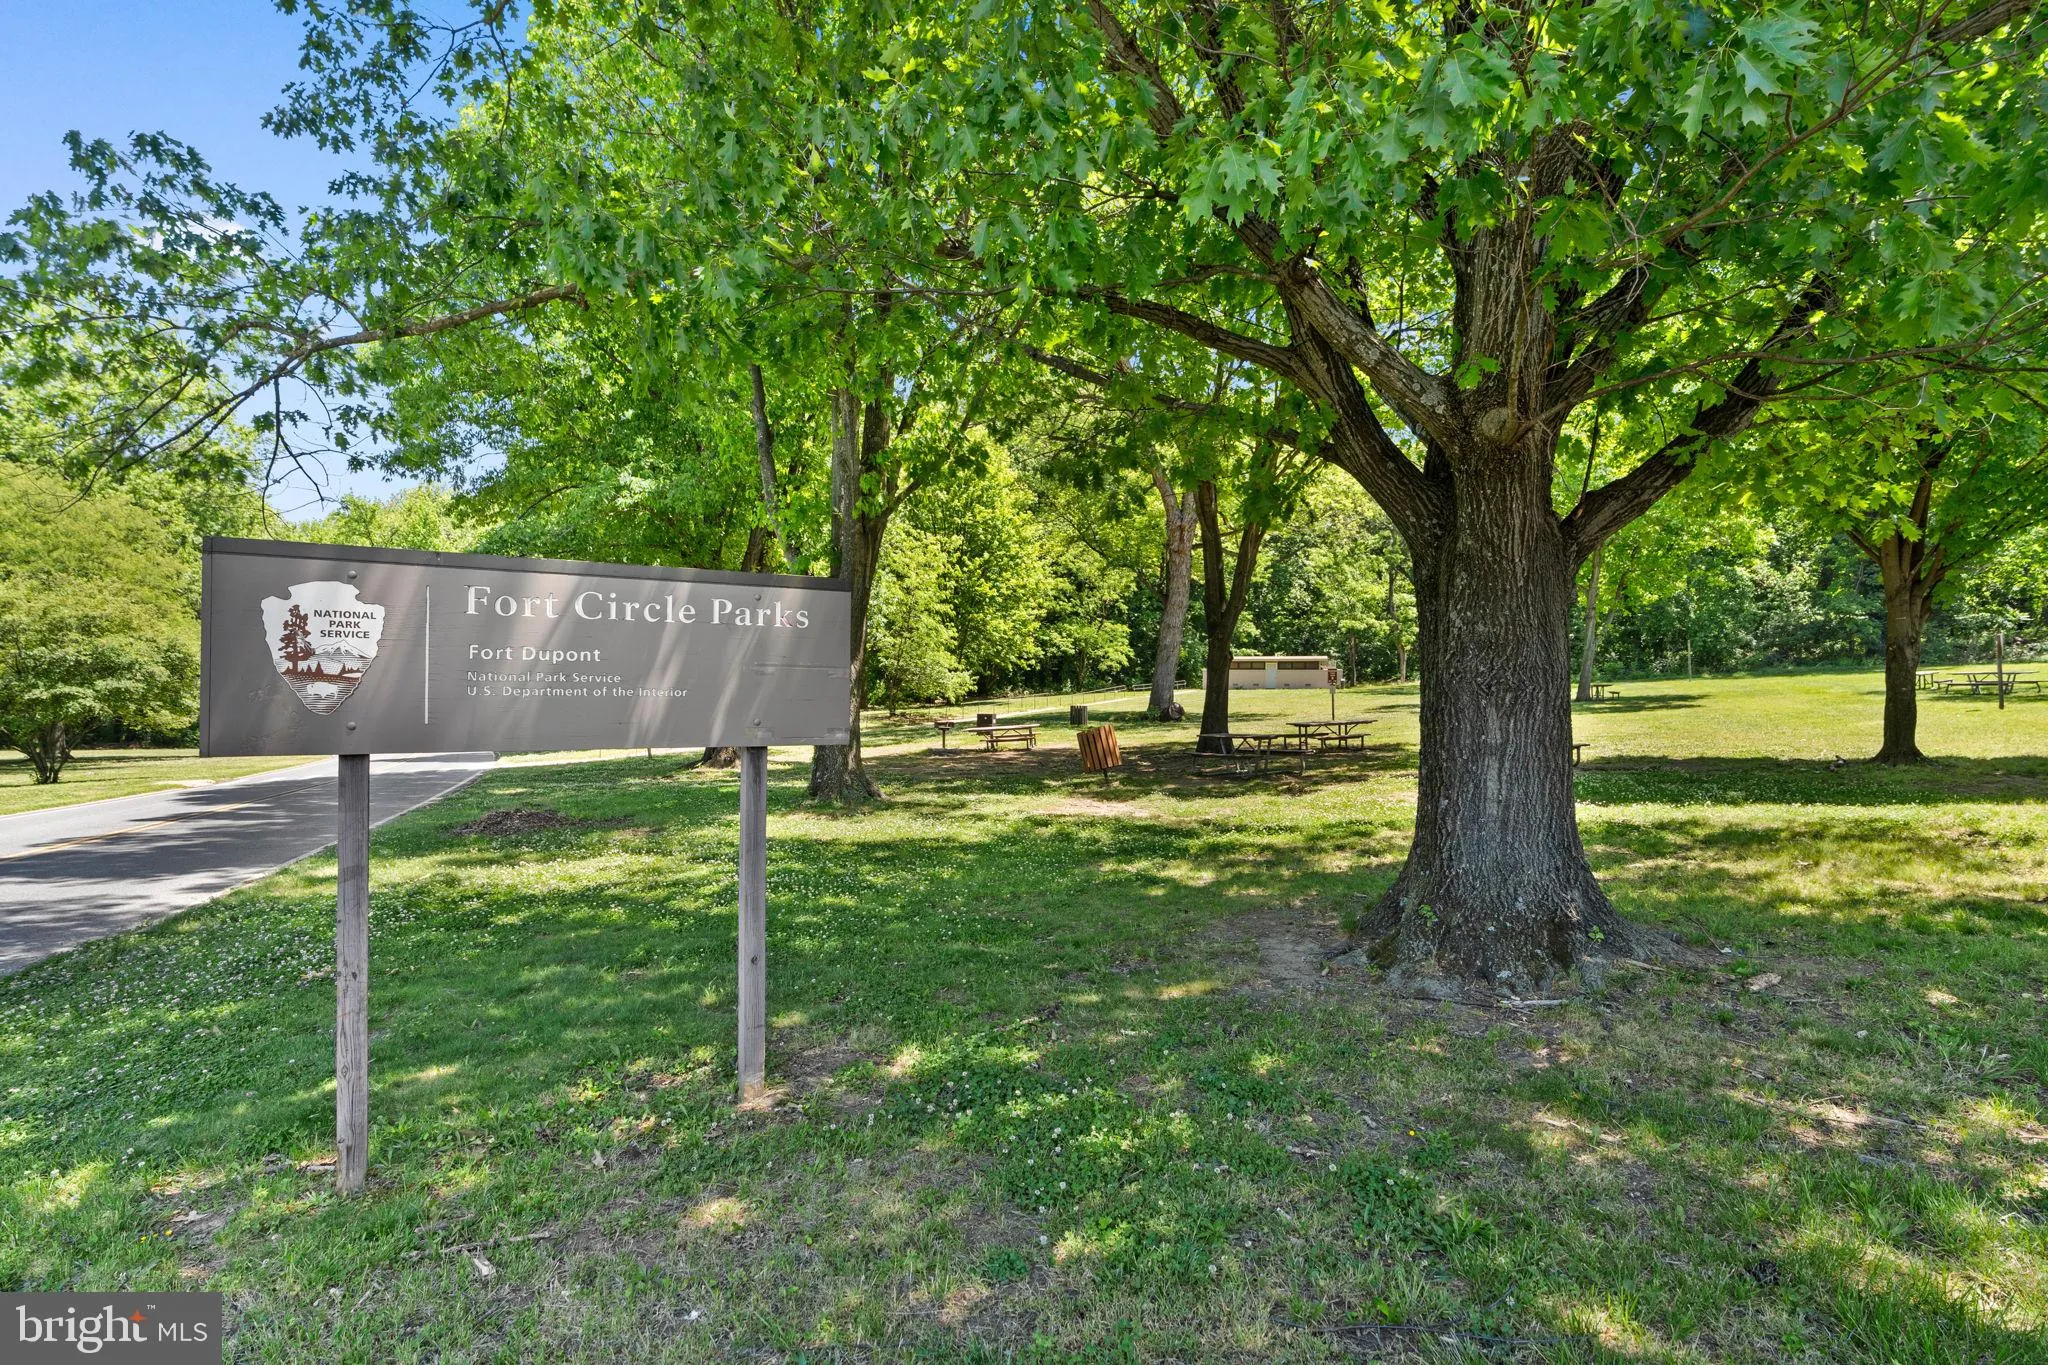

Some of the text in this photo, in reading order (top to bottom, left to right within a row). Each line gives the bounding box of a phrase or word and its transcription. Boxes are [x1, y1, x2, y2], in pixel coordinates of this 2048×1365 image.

[464, 584, 810, 629] Fort Circle Parks
[313, 609, 377, 620] NATIONAL
[329, 620, 361, 629] PARK
[320, 630, 370, 639] SERVICE
[468, 644, 601, 665] Fort Dupont
[466, 671, 622, 684] National Park Service
[466, 686, 688, 700] U.S. Department of the Interior
